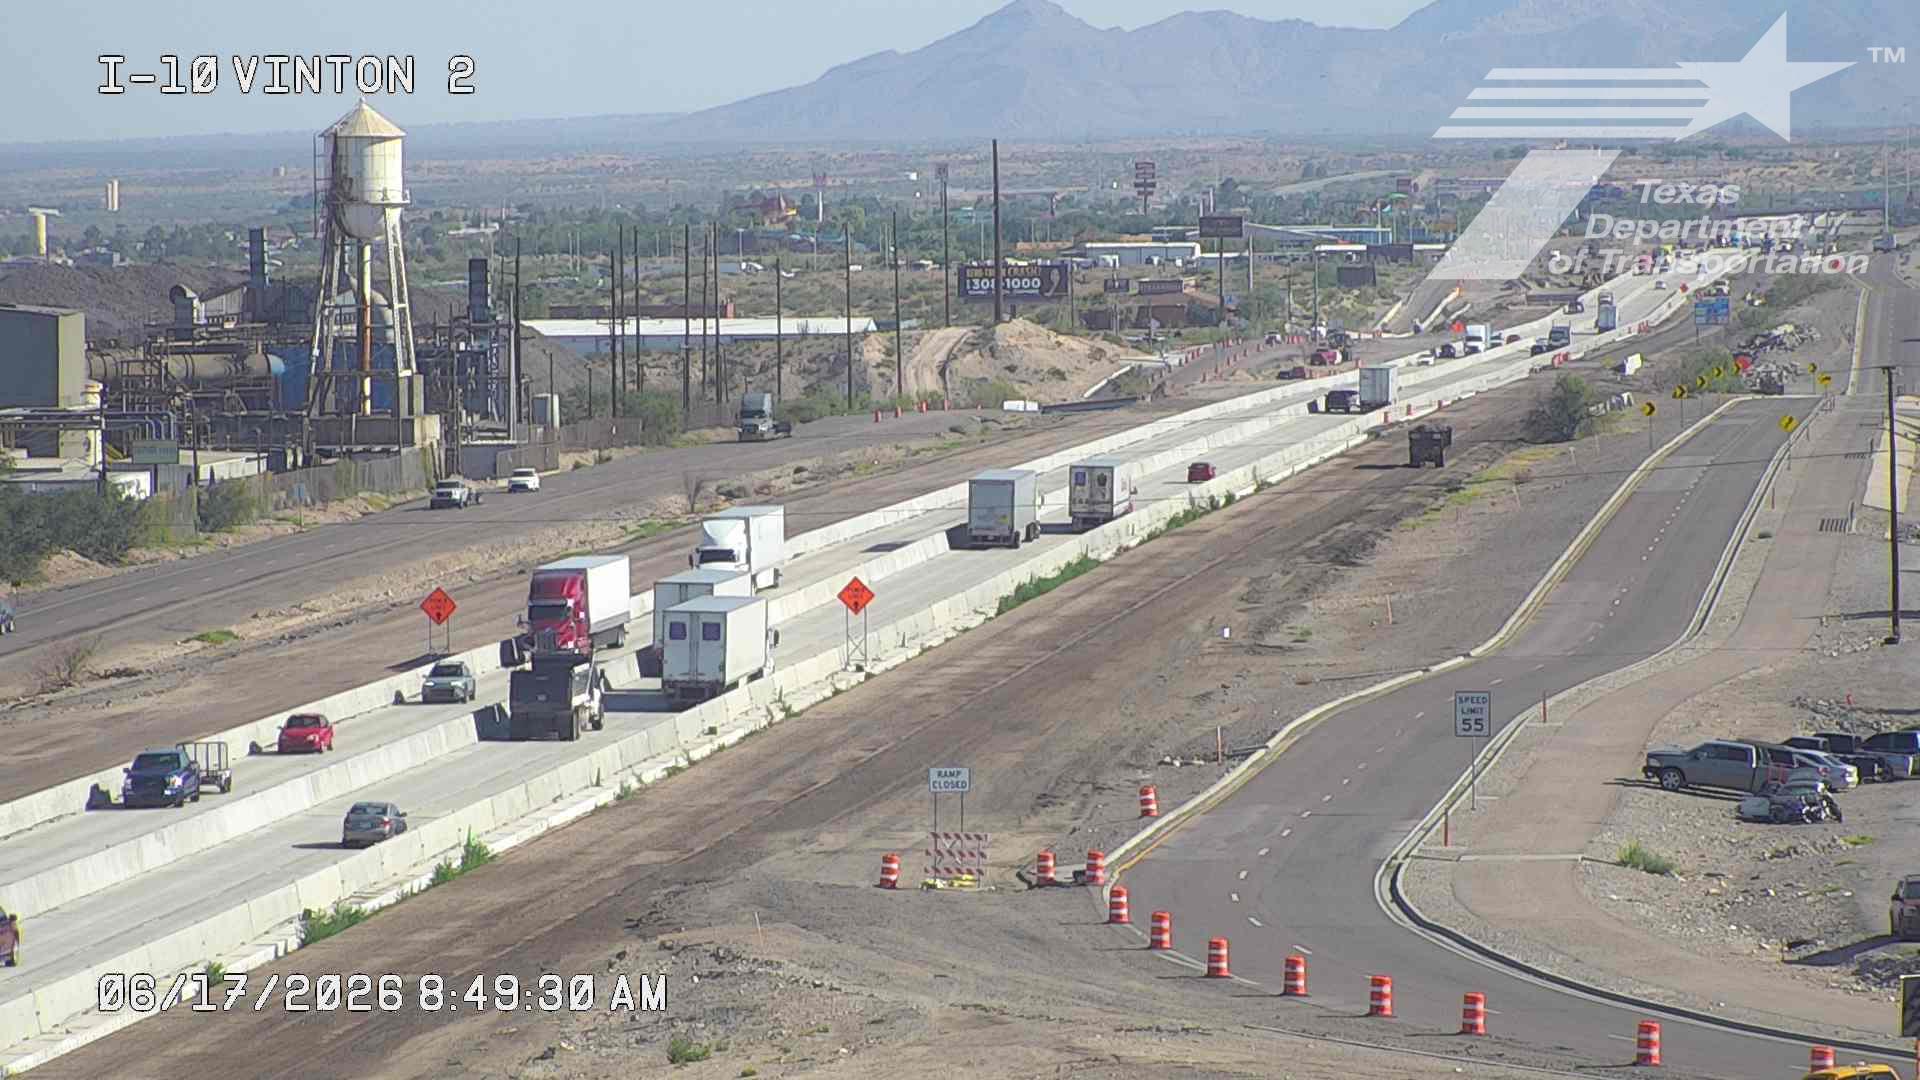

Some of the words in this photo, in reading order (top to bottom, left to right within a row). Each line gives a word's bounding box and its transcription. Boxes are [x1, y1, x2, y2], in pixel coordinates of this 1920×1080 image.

[1458, 696, 1488, 704] SPEED
[1462, 718, 1484, 732] 55
[932, 780, 968, 789] CLOSED
